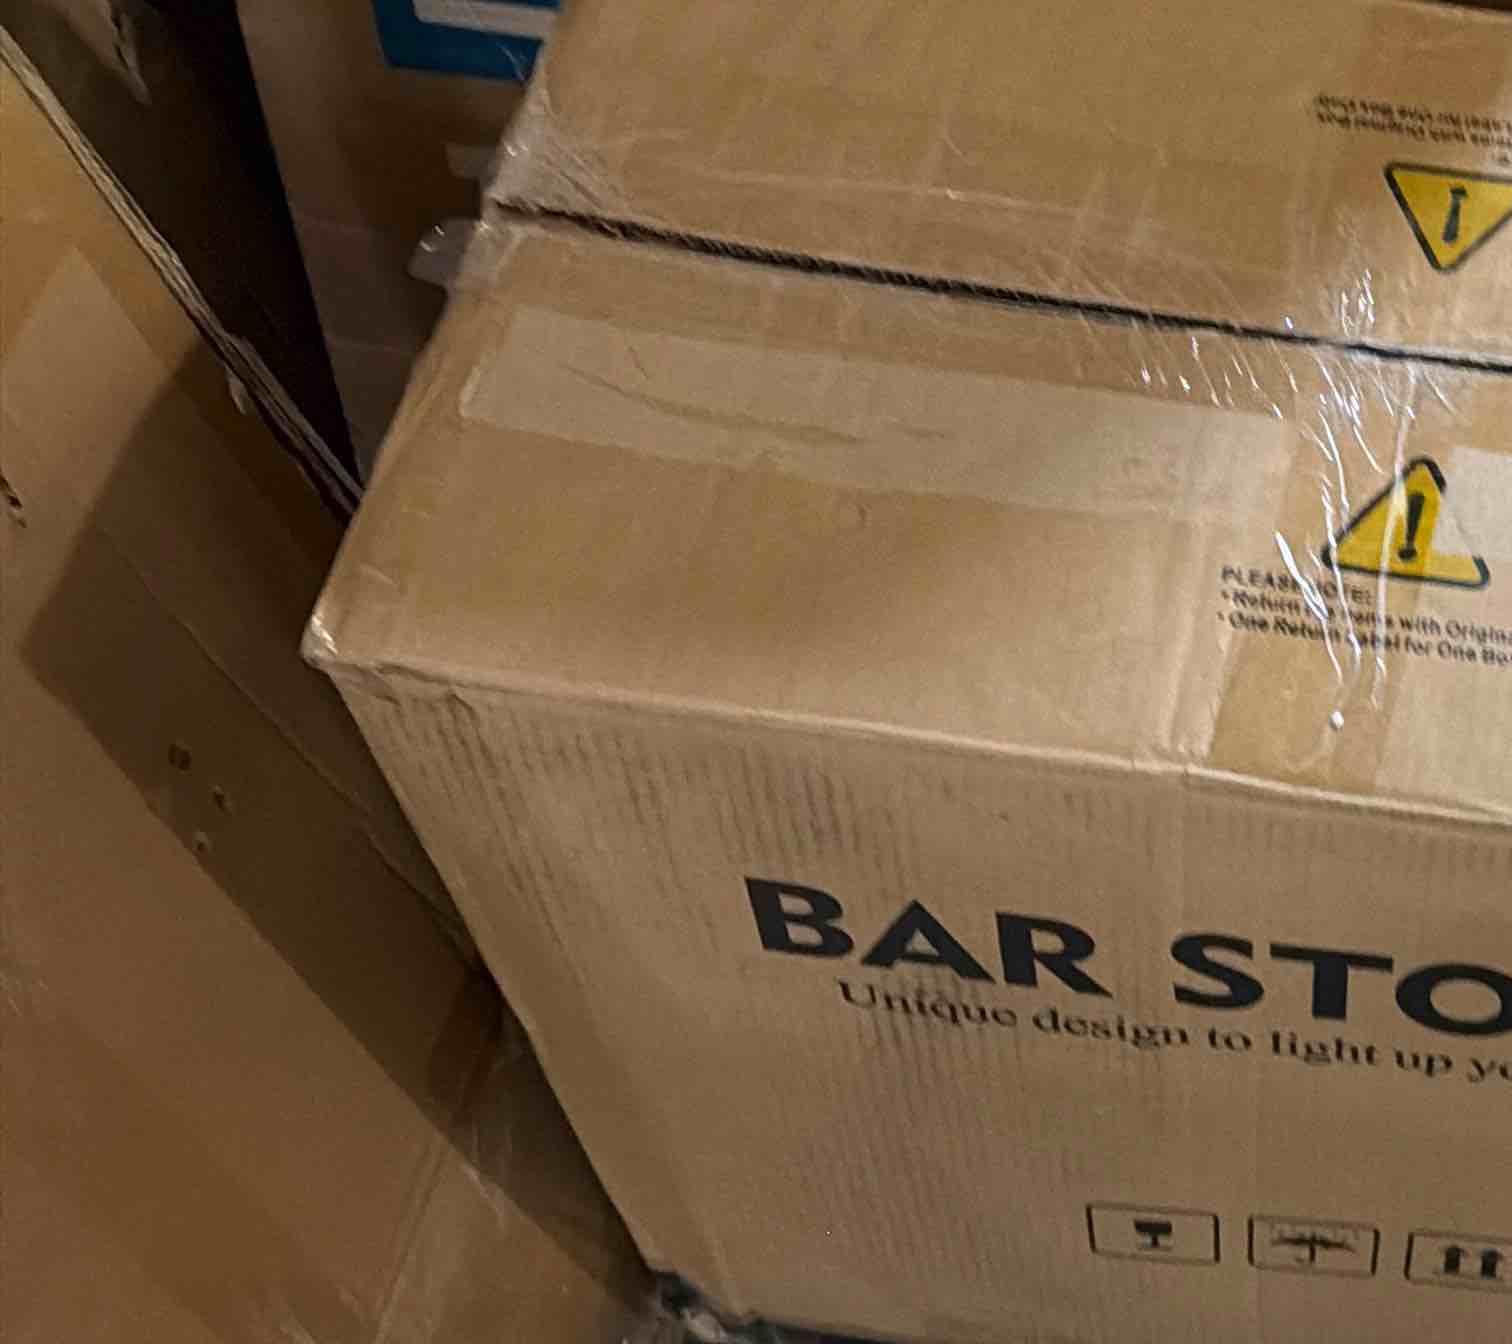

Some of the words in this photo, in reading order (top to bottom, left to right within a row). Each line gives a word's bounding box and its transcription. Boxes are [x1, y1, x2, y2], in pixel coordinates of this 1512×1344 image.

[1399, 614, 1441, 636] with
[1404, 635, 1431, 657] for
[1437, 640, 1477, 663] One
[744, 877, 1113, 999] BAR
[838, 980, 1018, 1028] Unique
[1032, 1006, 1190, 1051] design
[1207, 1026, 1253, 1053] to
[1270, 1030, 1377, 1067] light
[1395, 1045, 1454, 1079] up
